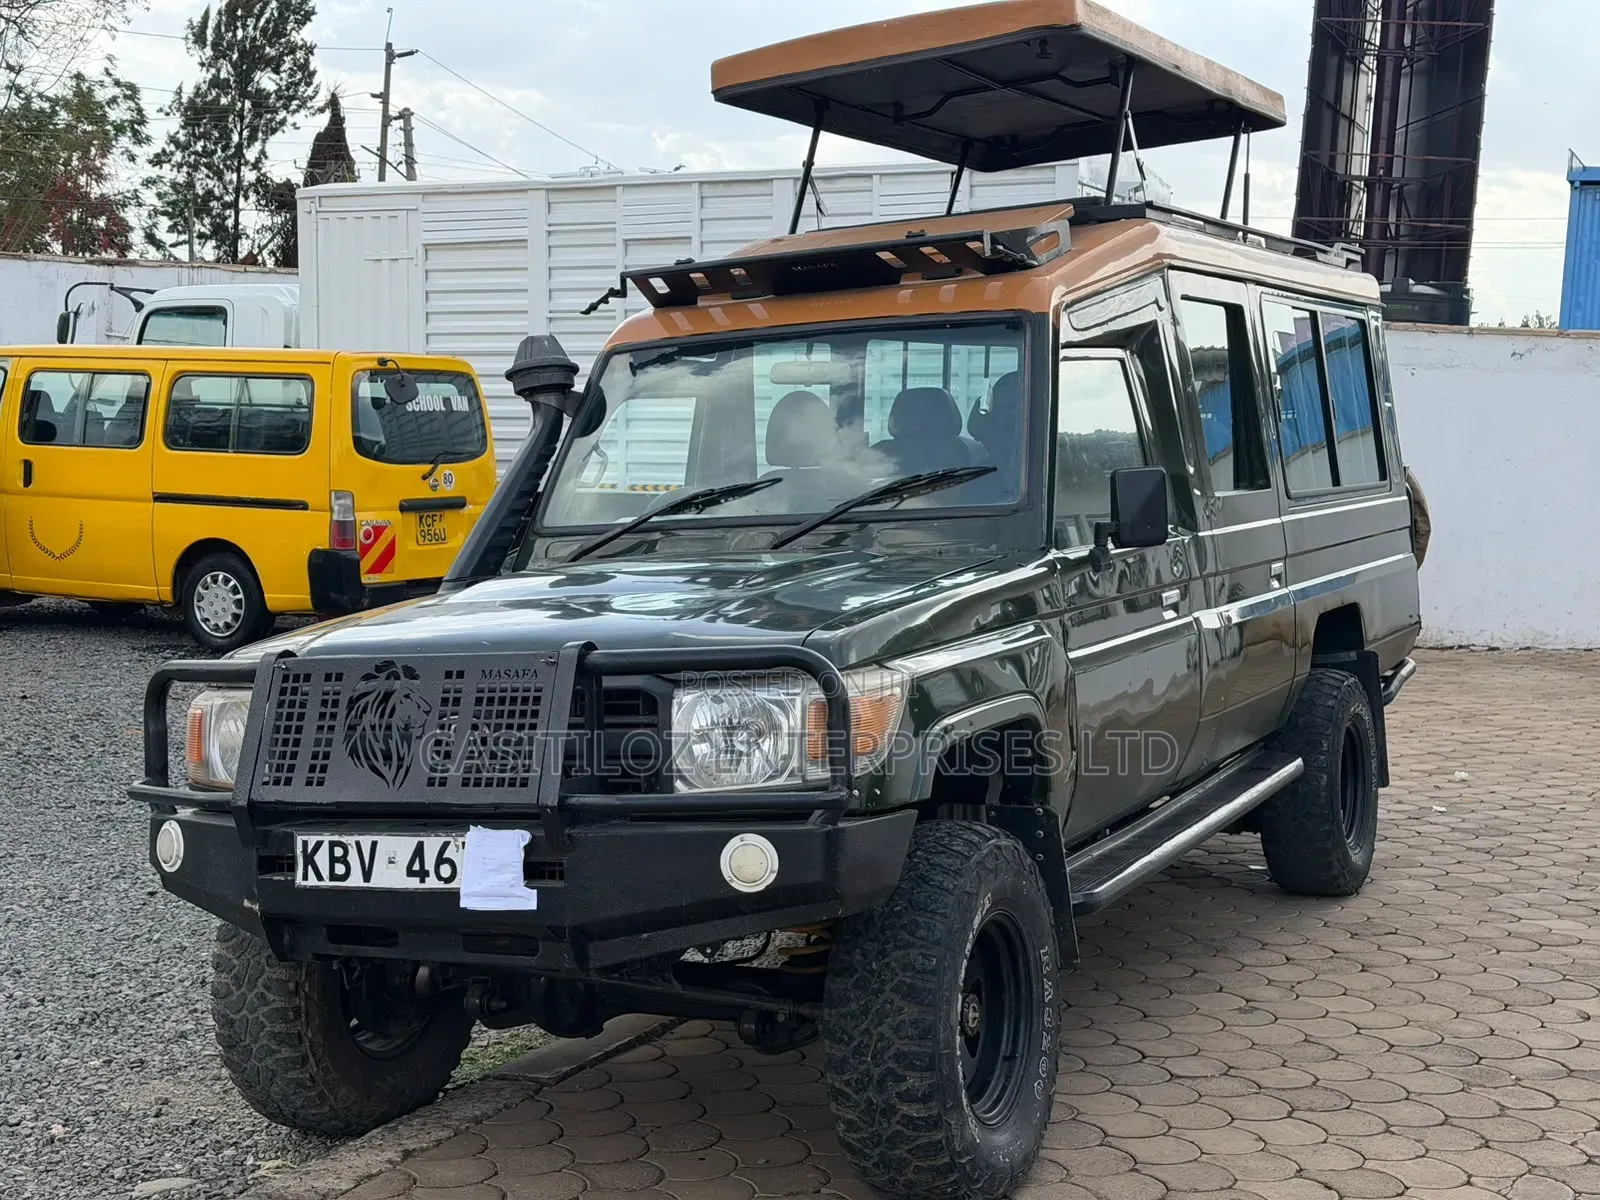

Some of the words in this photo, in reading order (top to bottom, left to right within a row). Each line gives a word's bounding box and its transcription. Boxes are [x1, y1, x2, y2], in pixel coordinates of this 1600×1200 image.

[406, 395, 446, 411] SCHOOL
[450, 395, 469, 412] VAN
[443, 472, 453, 485] 80
[418, 513, 437, 528] KCF
[420, 528, 447, 543] 956U
[480, 669, 538, 680] MASAFA
[301, 839, 379, 883] KBV
[406, 840, 465, 884] 46
